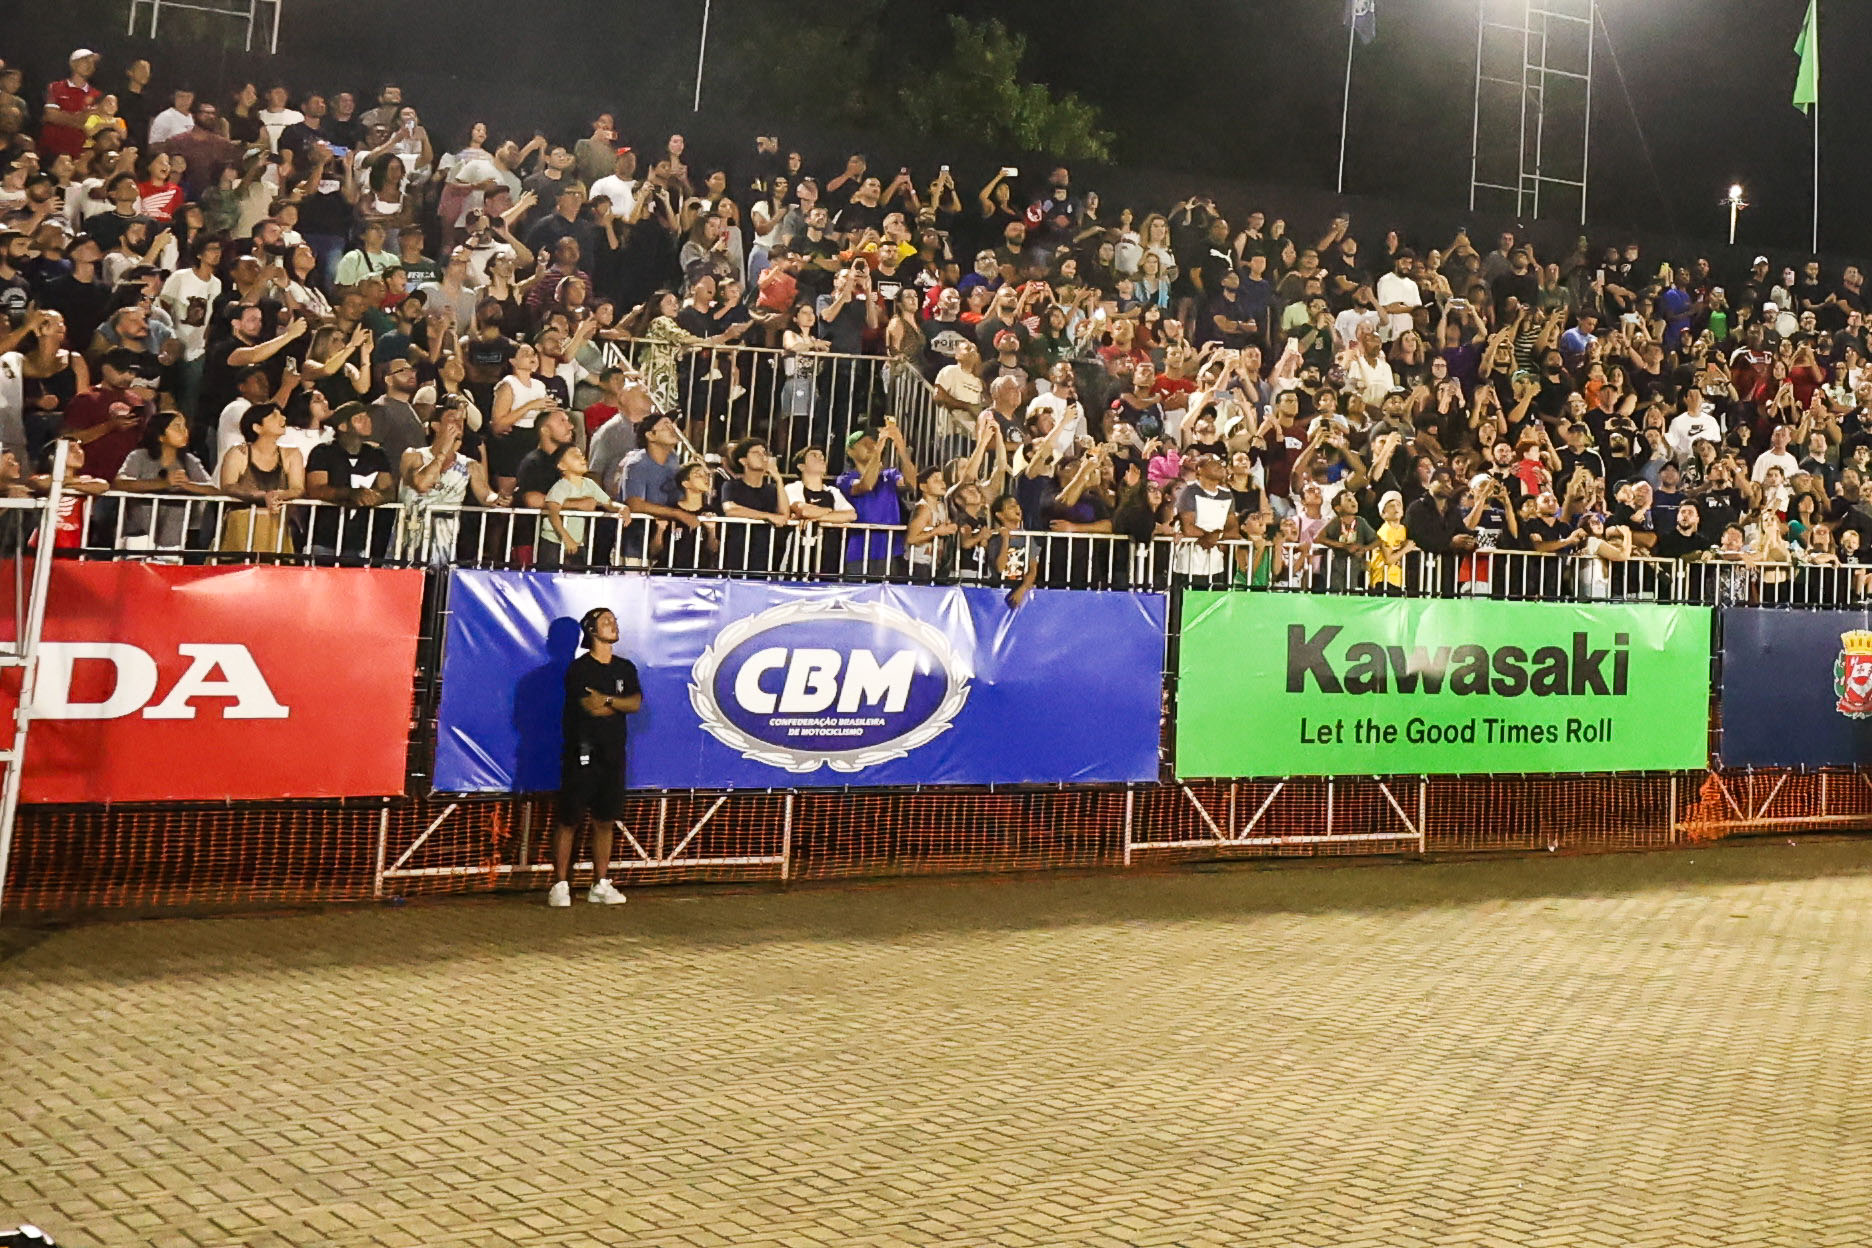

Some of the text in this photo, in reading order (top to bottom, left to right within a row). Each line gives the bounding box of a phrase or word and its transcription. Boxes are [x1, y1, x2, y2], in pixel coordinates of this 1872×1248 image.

[0, 641, 290, 720] DA
[735, 647, 917, 714] CBM
[1286, 624, 1629, 697] Kawasaki
[769, 716, 838, 728] CONFEDERAÇÃO
[788, 728, 864, 736] DE MOTOCICLISMO
[1300, 718, 1612, 744] Let the Good Times Roll
